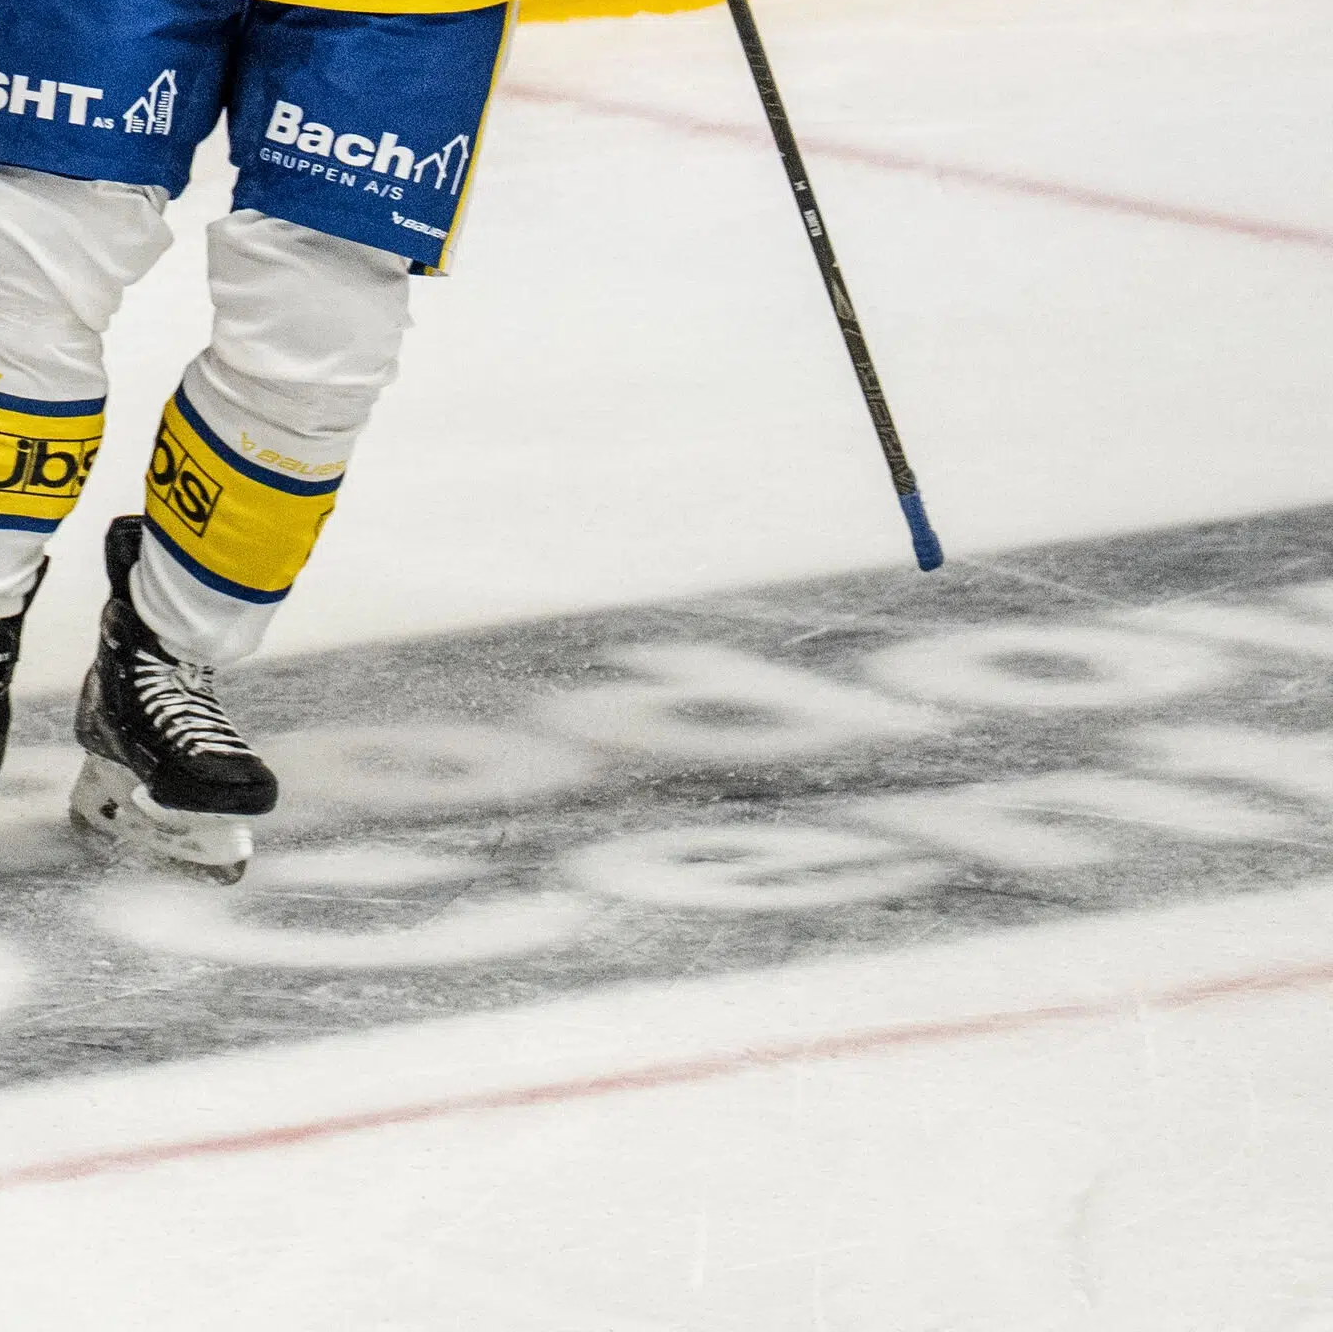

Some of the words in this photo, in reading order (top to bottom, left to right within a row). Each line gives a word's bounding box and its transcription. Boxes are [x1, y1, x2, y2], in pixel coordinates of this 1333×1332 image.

[265, 99, 417, 180] Bach
[259, 147, 357, 188] GRUPPEN
[363, 180, 405, 201] A/S
